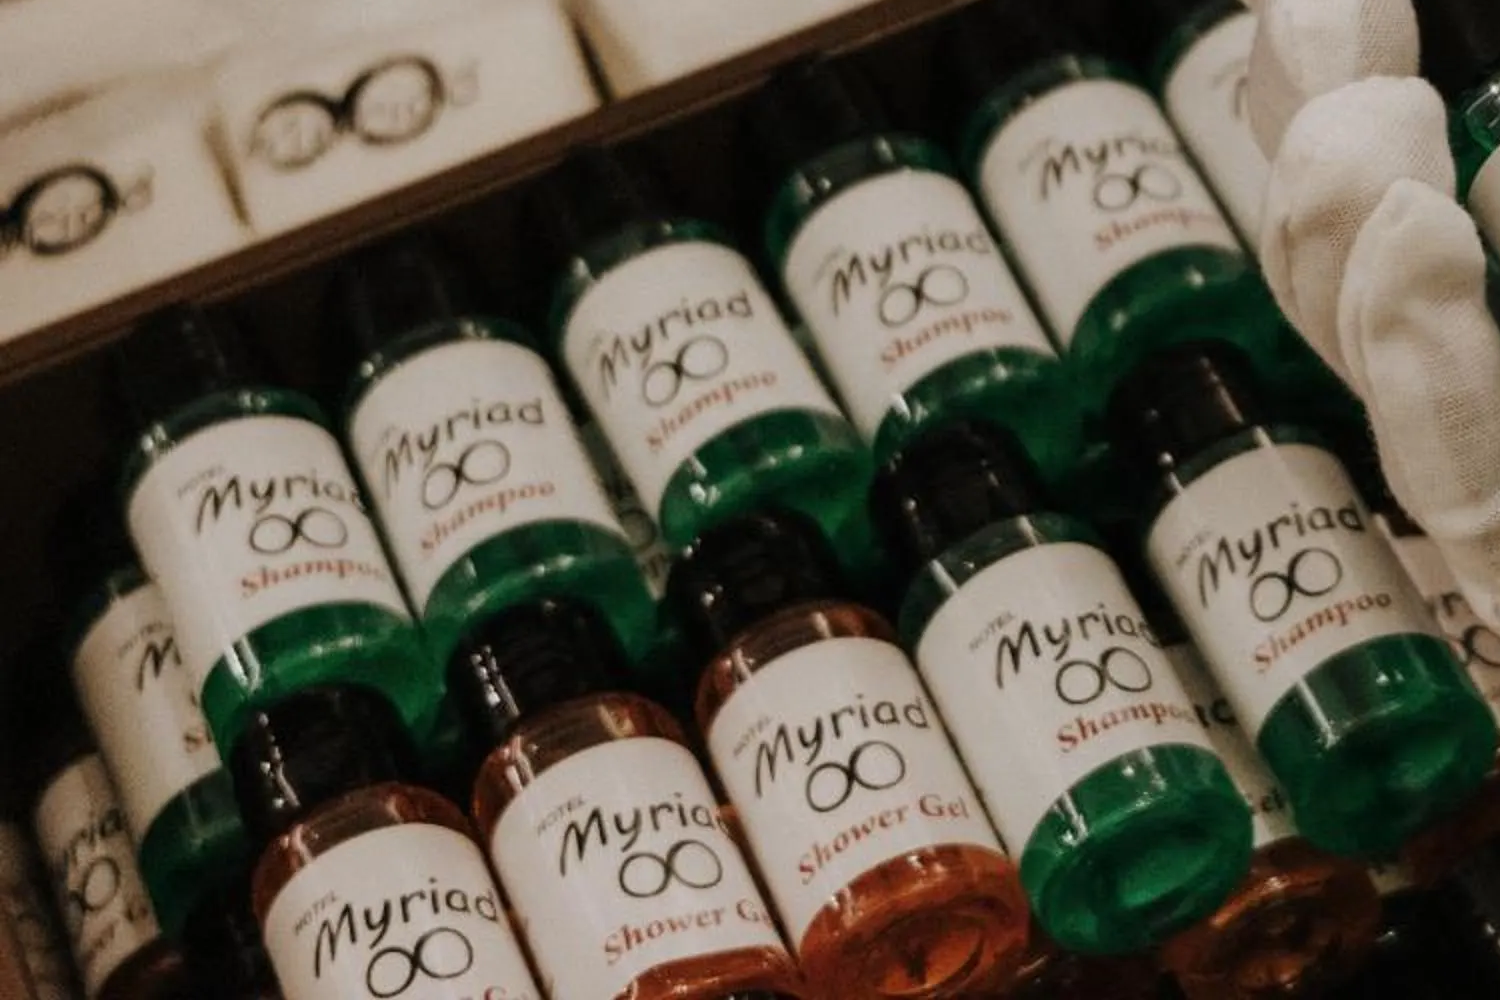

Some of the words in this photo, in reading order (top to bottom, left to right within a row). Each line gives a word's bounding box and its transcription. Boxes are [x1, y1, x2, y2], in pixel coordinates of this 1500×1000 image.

[597, 290, 753, 402] Myriad
[382, 397, 545, 502] Myriad
[1198, 502, 1366, 611] Myriad
[1253, 592, 1393, 674] Shampoo
[755, 693, 930, 799] Myriad
[559, 792, 724, 878] Myria
[798, 802, 911, 886] Shower
[918, 793, 970, 821] Gel
[314, 875, 499, 980] Myriad
[604, 904, 728, 967] Shower
[735, 897, 778, 931] Ge
